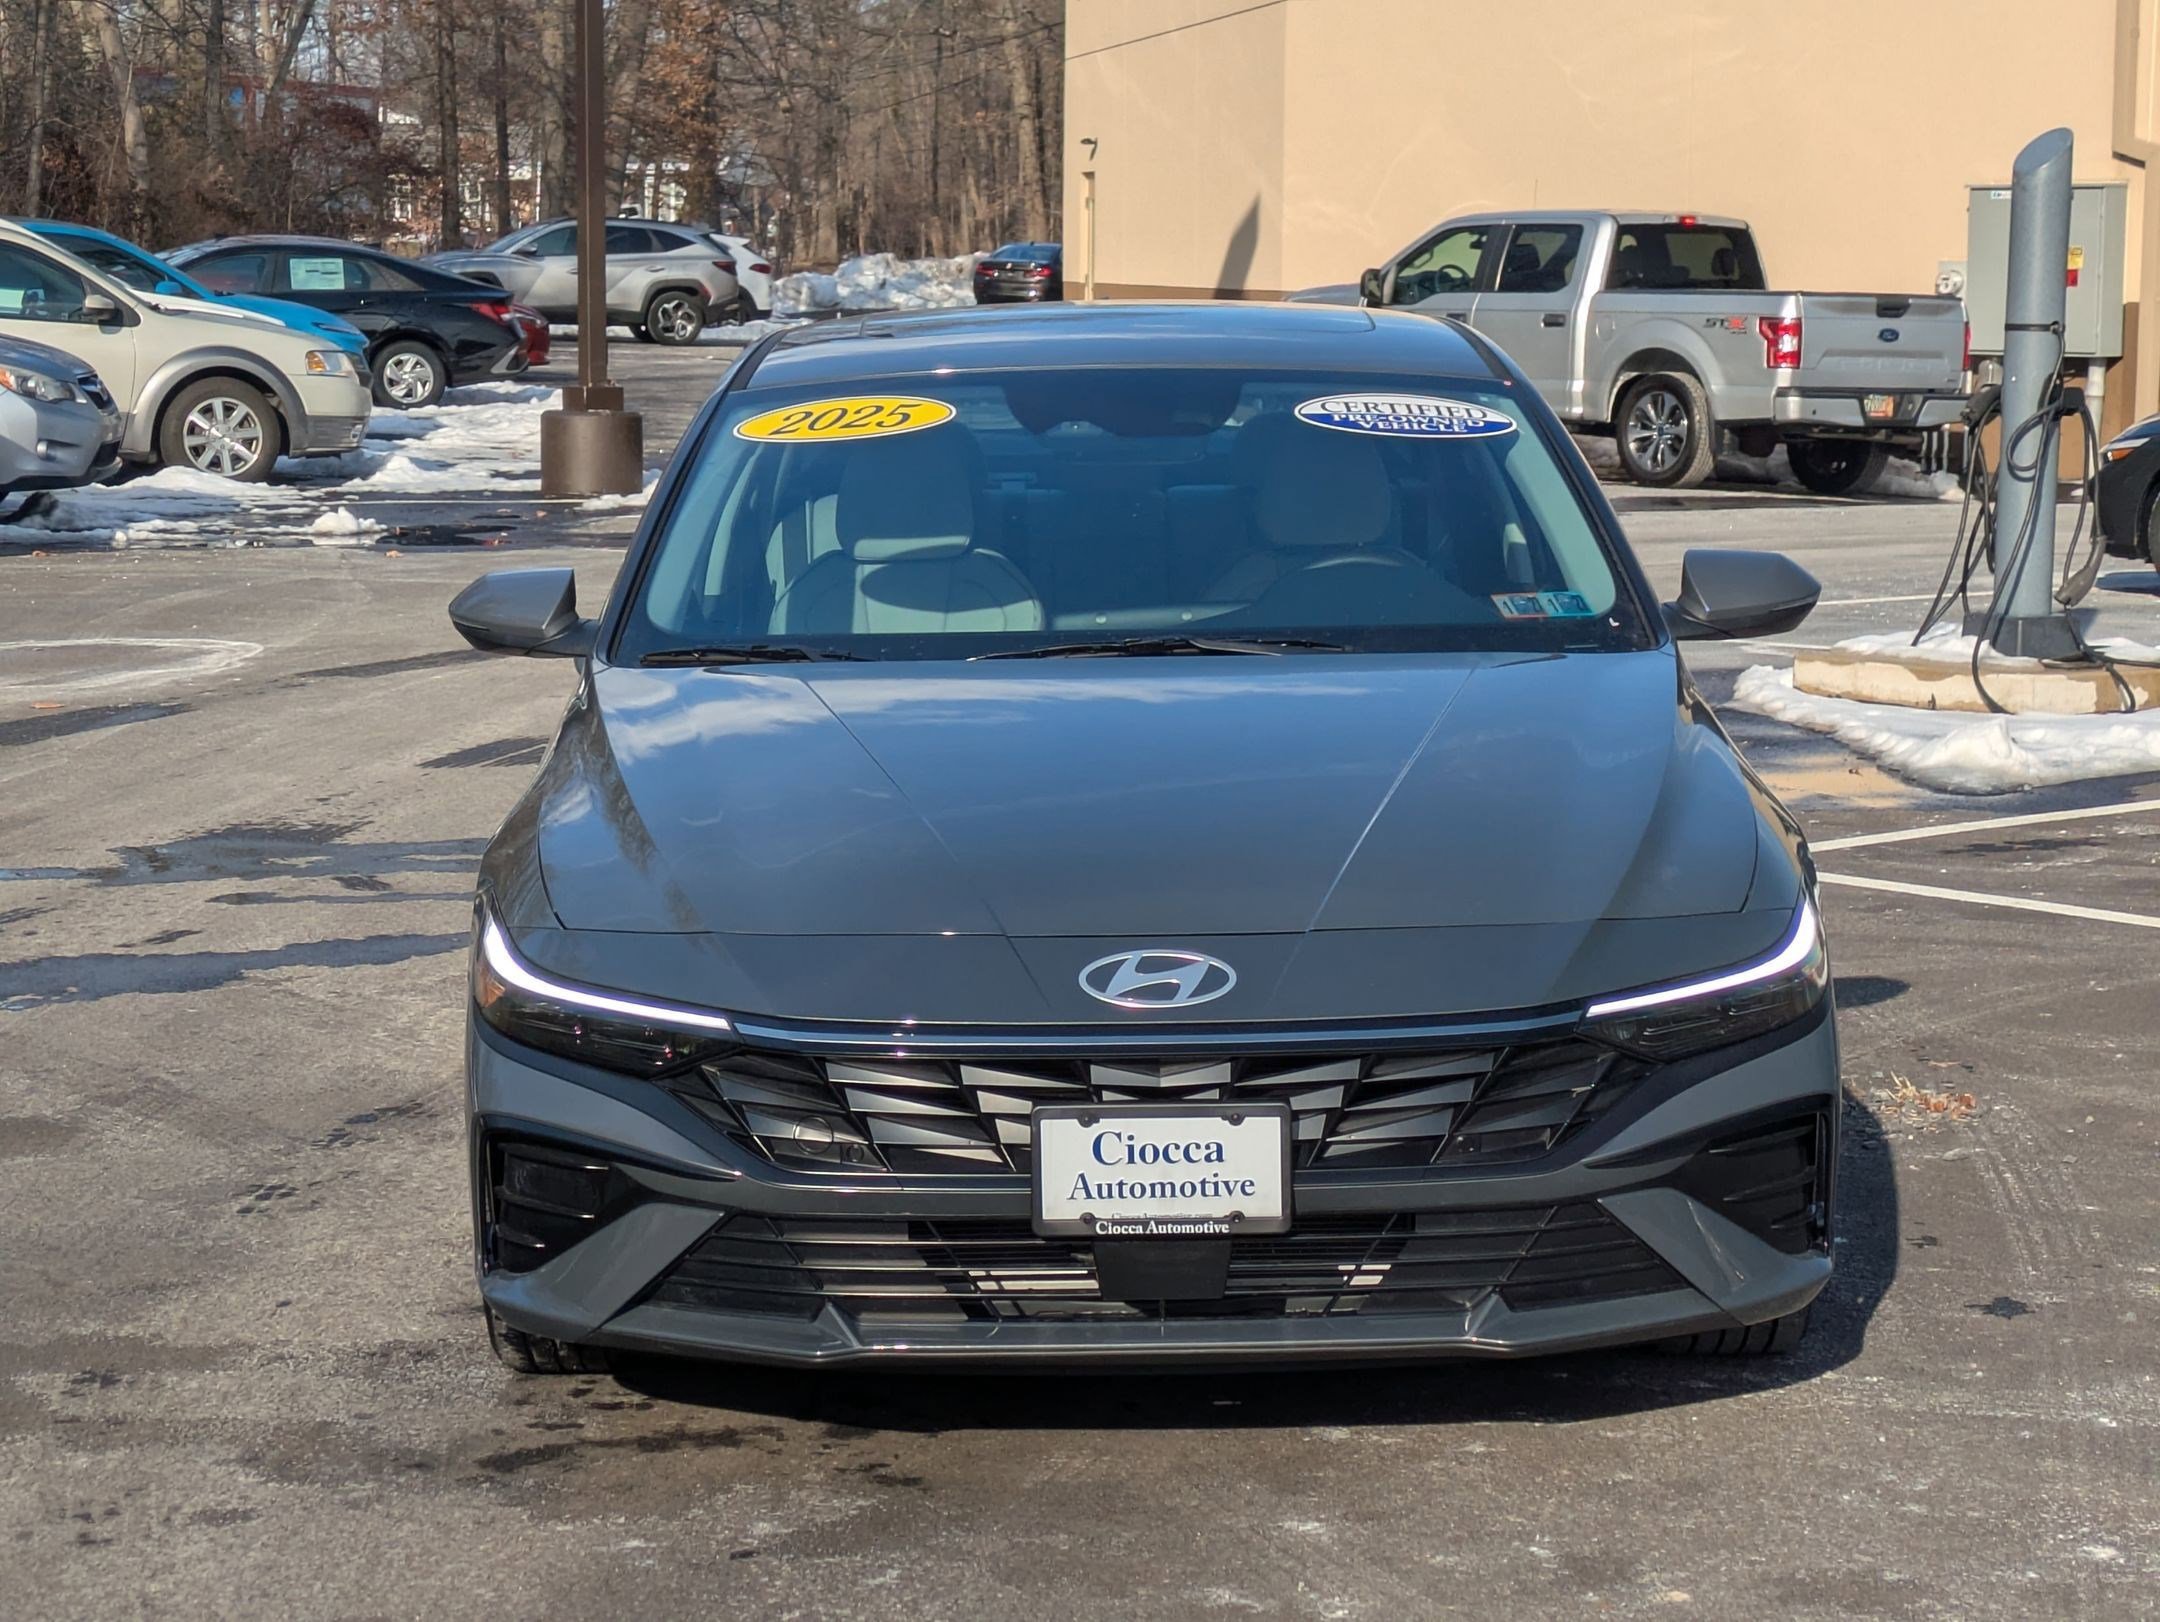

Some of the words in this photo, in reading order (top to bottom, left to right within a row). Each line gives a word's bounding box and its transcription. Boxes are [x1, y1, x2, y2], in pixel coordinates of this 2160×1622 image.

[1320, 401, 1488, 419] CERTIFIED
[769, 404, 922, 436] 2025
[1331, 413, 1485, 427] PRE-OWNED
[1358, 421, 1468, 433] VEHICLE
[1092, 1130, 1225, 1166] Ciocca
[1067, 1172, 1256, 1201] Automotive
[1095, 1221, 1143, 1235] Ciocca
[1145, 1220, 1231, 1234] Automotive
